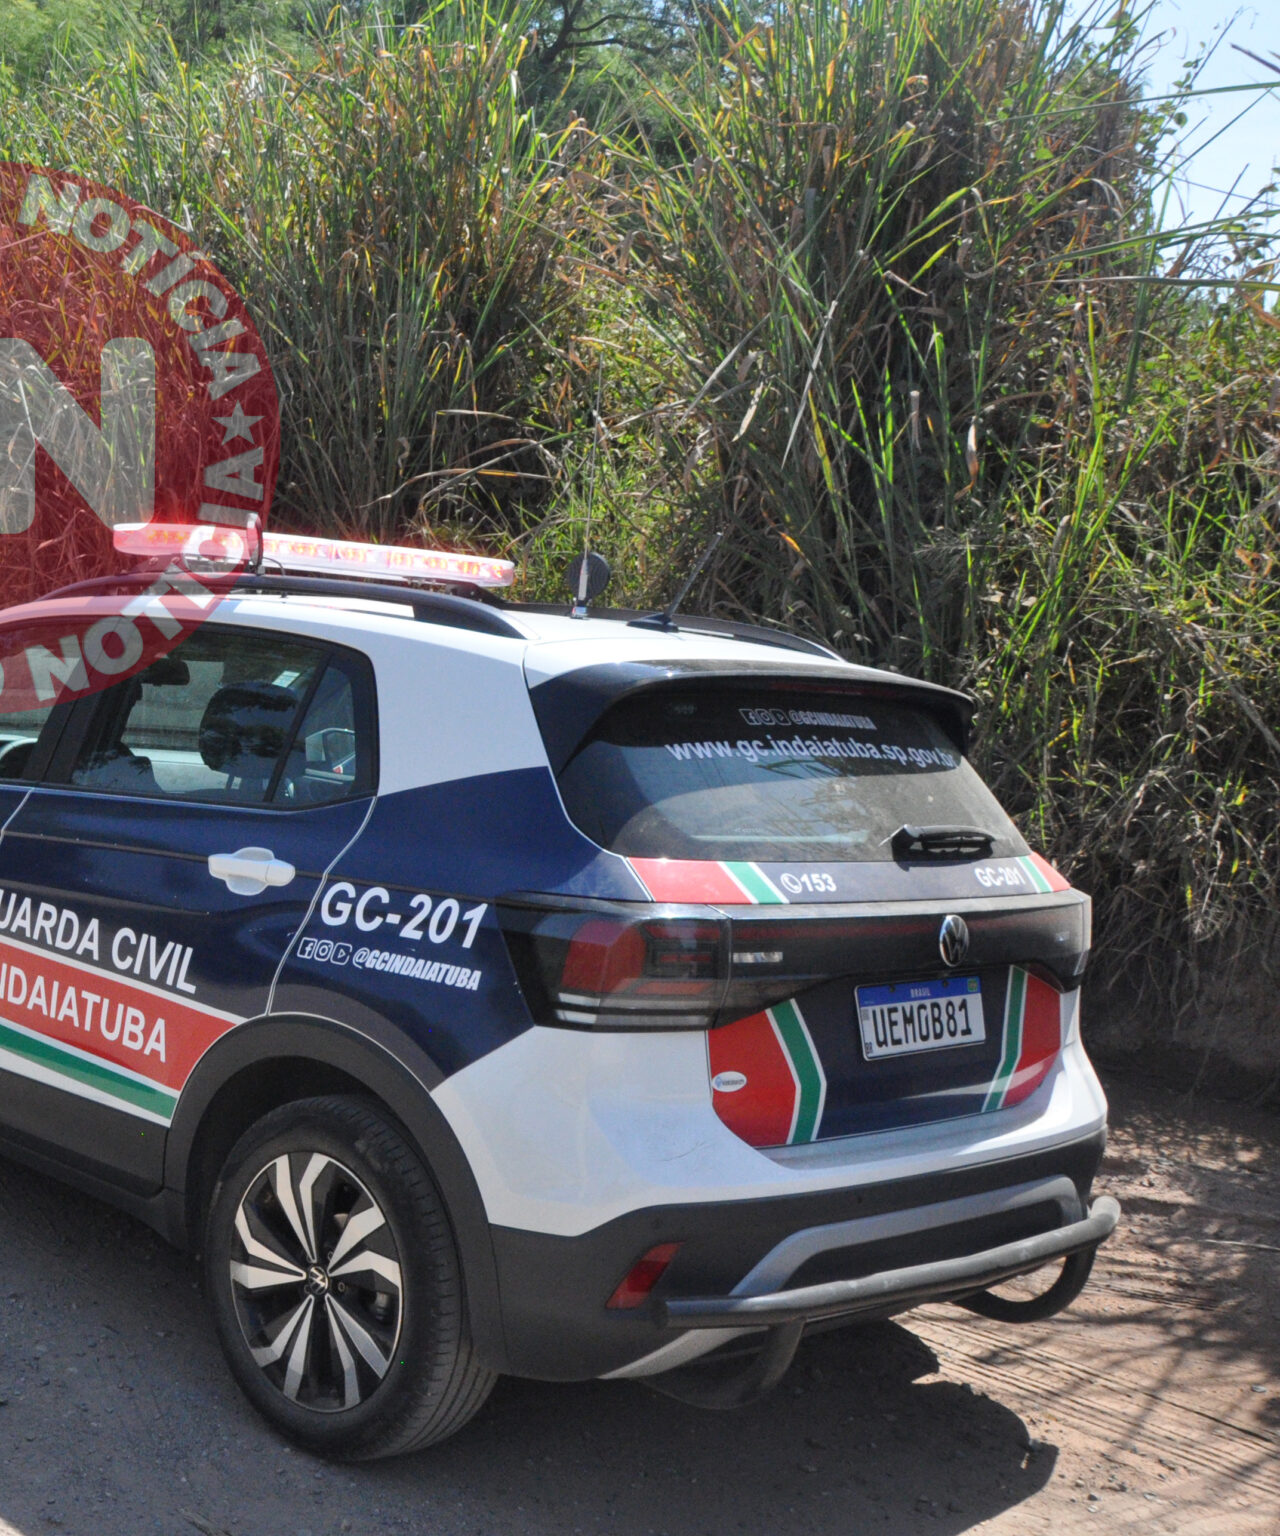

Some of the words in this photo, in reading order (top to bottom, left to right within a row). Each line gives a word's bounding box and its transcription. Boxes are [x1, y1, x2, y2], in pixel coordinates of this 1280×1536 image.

[665, 735, 956, 768] www.gc.indaiatuba.sp.gov.br
[800, 872, 837, 892] 153
[974, 866, 1026, 888] GC-201
[321, 881, 488, 949] GC-201
[111, 927, 197, 994] CIVIL
[352, 947, 482, 991] @GCINDAIATUBA
